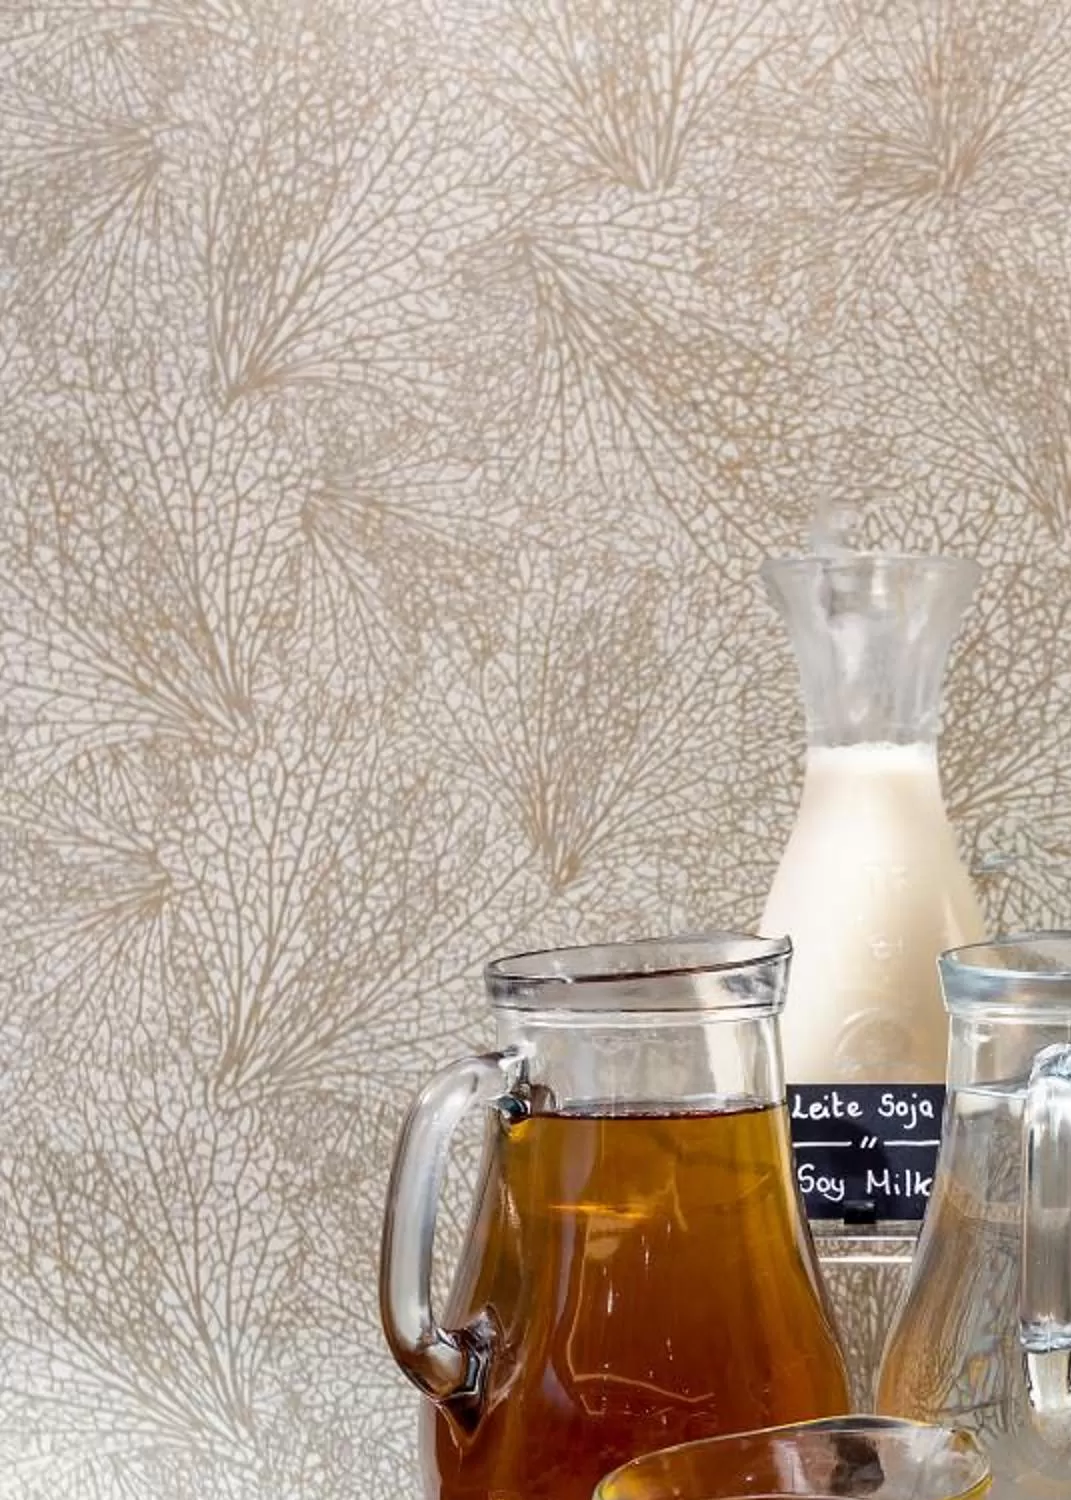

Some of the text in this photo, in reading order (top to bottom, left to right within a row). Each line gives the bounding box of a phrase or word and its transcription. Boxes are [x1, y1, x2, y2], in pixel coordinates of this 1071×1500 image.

[791, 1091, 935, 1130] Leite Soja
[797, 1163, 934, 1202] Soy Milk
